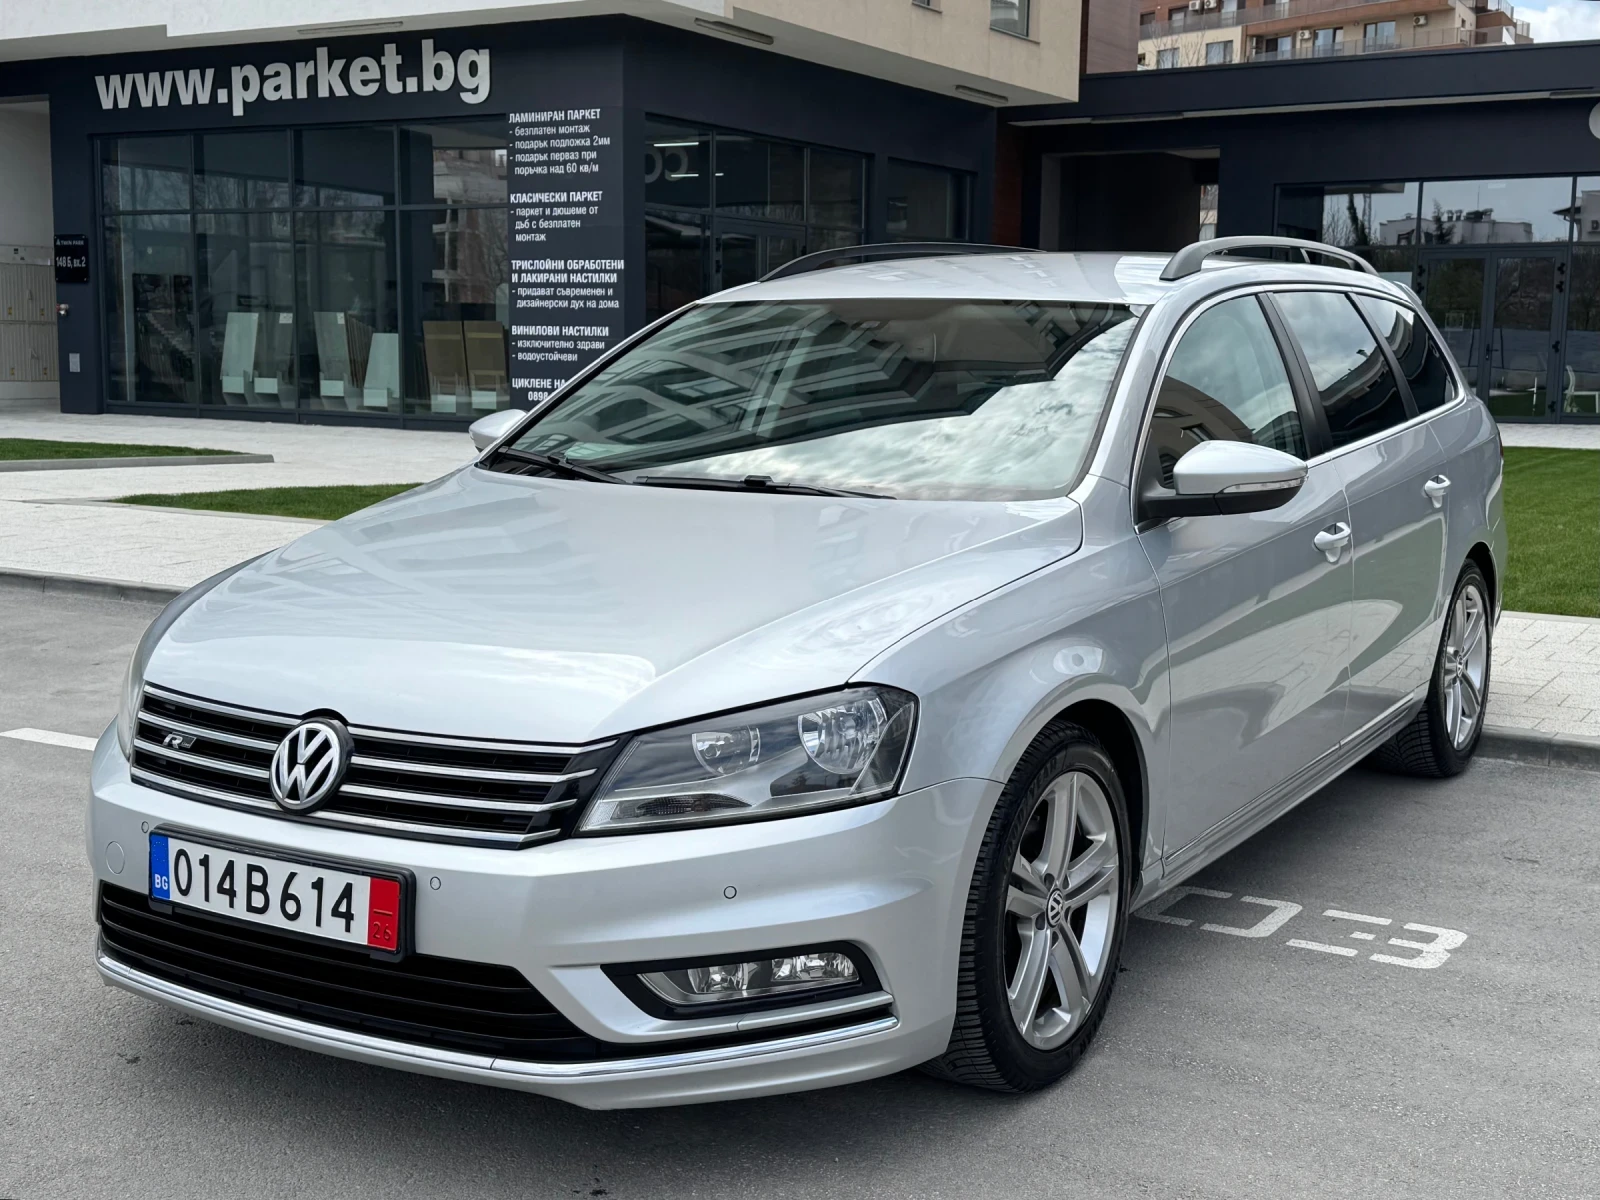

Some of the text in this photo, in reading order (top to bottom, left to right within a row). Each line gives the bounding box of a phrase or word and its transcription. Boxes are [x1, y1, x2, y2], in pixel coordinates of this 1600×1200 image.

[95, 39, 491, 117] www.parket.bg
[509, 109, 600, 123] ЛАМИНИРАН ПАРКЕТ
[515, 126, 556, 136] безплатен
[559, 124, 590, 134] монтаж
[515, 139, 548, 150] подарък
[550, 137, 590, 148] подложка
[593, 136, 610, 145] 2мм
[516, 152, 548, 163] подарък
[550, 151, 579, 162] перваз
[582, 151, 597, 161] при
[515, 162, 598, 176] поръчка над 60 кв/м
[510, 191, 602, 203] КЛАСИЧЕСКИ ПАРКЕТ
[516, 208, 542, 218] паркет
[552, 206, 586, 216] дюшеме
[589, 206, 598, 214] от
[515, 219, 530, 230] дъб
[539, 218, 580, 228] безплатен
[516, 233, 546, 242] монтаж
[512, 258, 624, 270] ТРИСЛОЙНИ ОБРАБОТЕНИ
[512, 273, 617, 283] И ЛАКИРАНИ НАСТИЛКИ
[518, 287, 554, 296] придават
[556, 288, 605, 297] съвременен
[608, 288, 613, 296] и
[516, 298, 619, 309] дизайнерски дух на дома
[512, 325, 609, 336] ВИНИЛОВИ НАСТИЛКИ
[518, 340, 574, 349] изключително
[577, 341, 604, 350] здрави
[518, 352, 578, 362] водоустойчеви
[512, 378, 552, 389] ЦИКЛЕНЕ
[154, 873, 169, 891] BG
[173, 848, 355, 933] 014B614
[373, 921, 393, 942] 26
